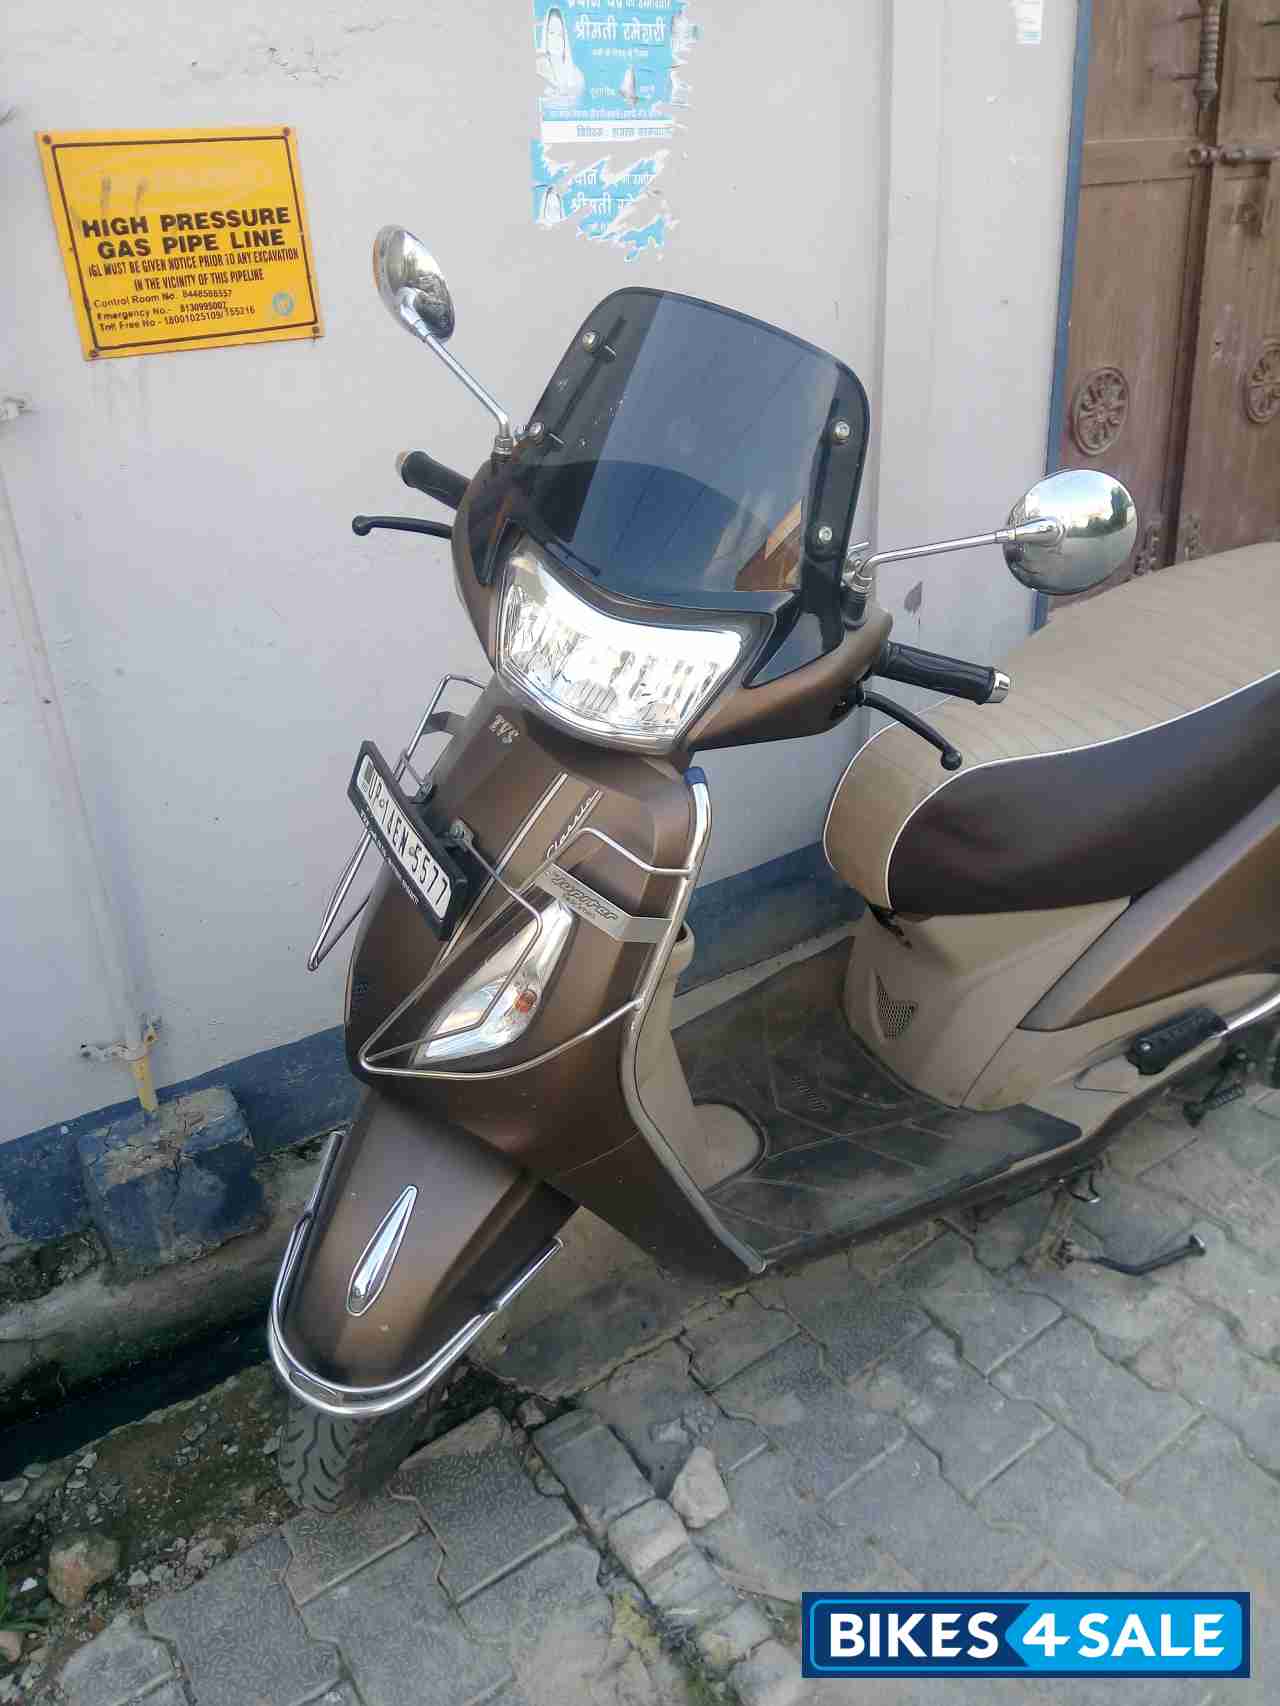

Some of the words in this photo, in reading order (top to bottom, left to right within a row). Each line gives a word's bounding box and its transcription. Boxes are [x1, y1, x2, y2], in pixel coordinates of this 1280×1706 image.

[575, 14, 618, 41] श्रीमती
[81, 216, 149, 238] HIGH
[160, 206, 291, 232] PRESSURE
[97, 238, 152, 260] GAS
[162, 233, 219, 255] PIPE
[229, 228, 286, 250] LINE
[104, 261, 128, 276] MUST
[129, 260, 141, 275] BE
[142, 257, 168, 273] GIVEN
[168, 255, 197, 271] NOTICE
[199, 254, 224, 268] PRIOR
[225, 252, 236, 266] TO
[237, 250, 252, 265] ANY
[253, 247, 300, 263] EXCAVATION
[134, 278, 144, 291] IN
[145, 276, 161, 290] THE
[162, 273, 197, 289] VICINITY
[198, 272, 209, 286] OF
[209, 271, 229, 285] THIS
[230, 268, 265, 283] PIPELINE
[94, 296, 130, 308] Control
[131, 294, 159, 304] Room
[97, 309, 150, 320] Emergency
